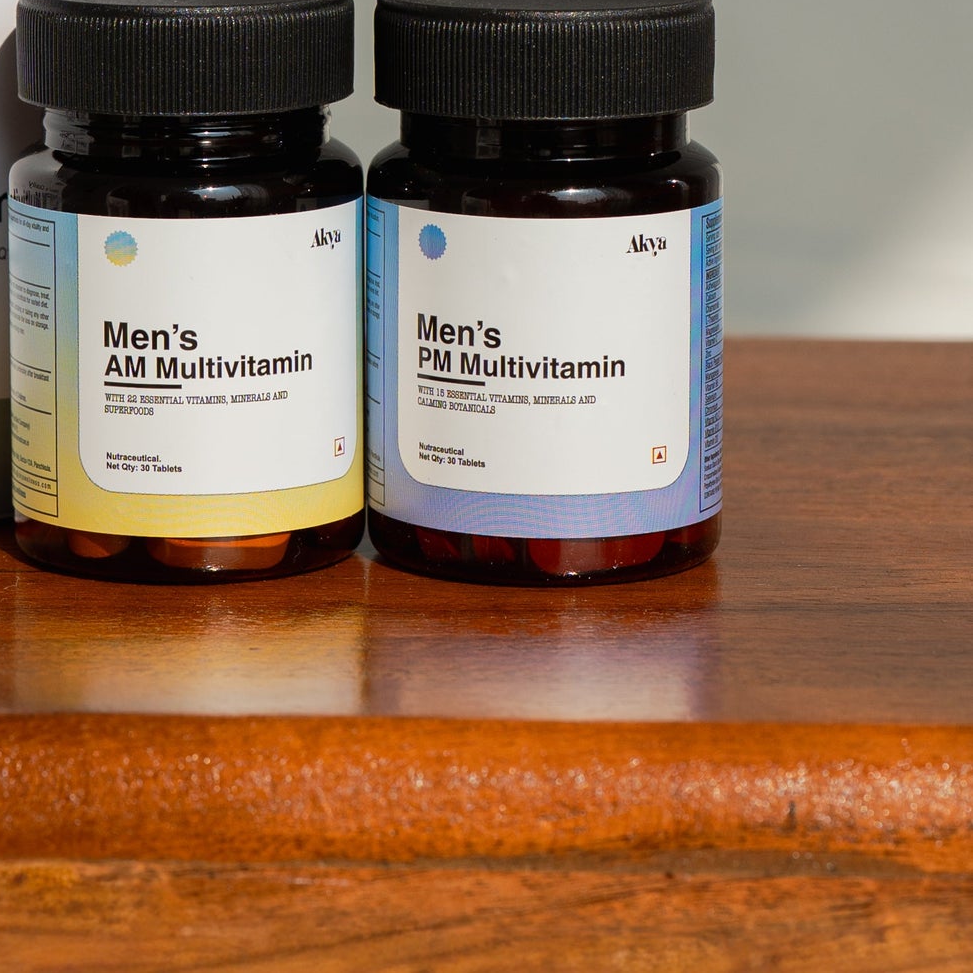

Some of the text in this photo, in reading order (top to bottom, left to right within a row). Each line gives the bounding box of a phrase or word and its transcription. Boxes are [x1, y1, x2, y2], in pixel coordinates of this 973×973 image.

[310, 227, 342, 250] Akya
[625, 233, 668, 257] Akya
[103, 320, 199, 351] Men's
[417, 312, 502, 349] Men's
[104, 349, 313, 380] AM Multivitamin
[418, 346, 626, 379] PM Multivitamin
[104, 390, 289, 406] WITH 22 ESSENTIAL VITAMINS, MINERALS AND
[417, 384, 435, 398] WITH
[446, 389, 487, 403] ESSENTIAL
[488, 393, 531, 406] VITAMINS,
[532, 395, 577, 405] MINERALS
[578, 395, 597, 404] AND
[104, 404, 154, 416] SUPERFOODS
[417, 396, 496, 415] CALMING BOTANICALS
[106, 451, 162, 463] Nutraceutical.
[418, 441, 465, 456] Nutraceutical
[106, 462, 183, 473] Net Qty: 30 Tablets
[418, 451, 486, 469] Net Qty: 30 Tablets
